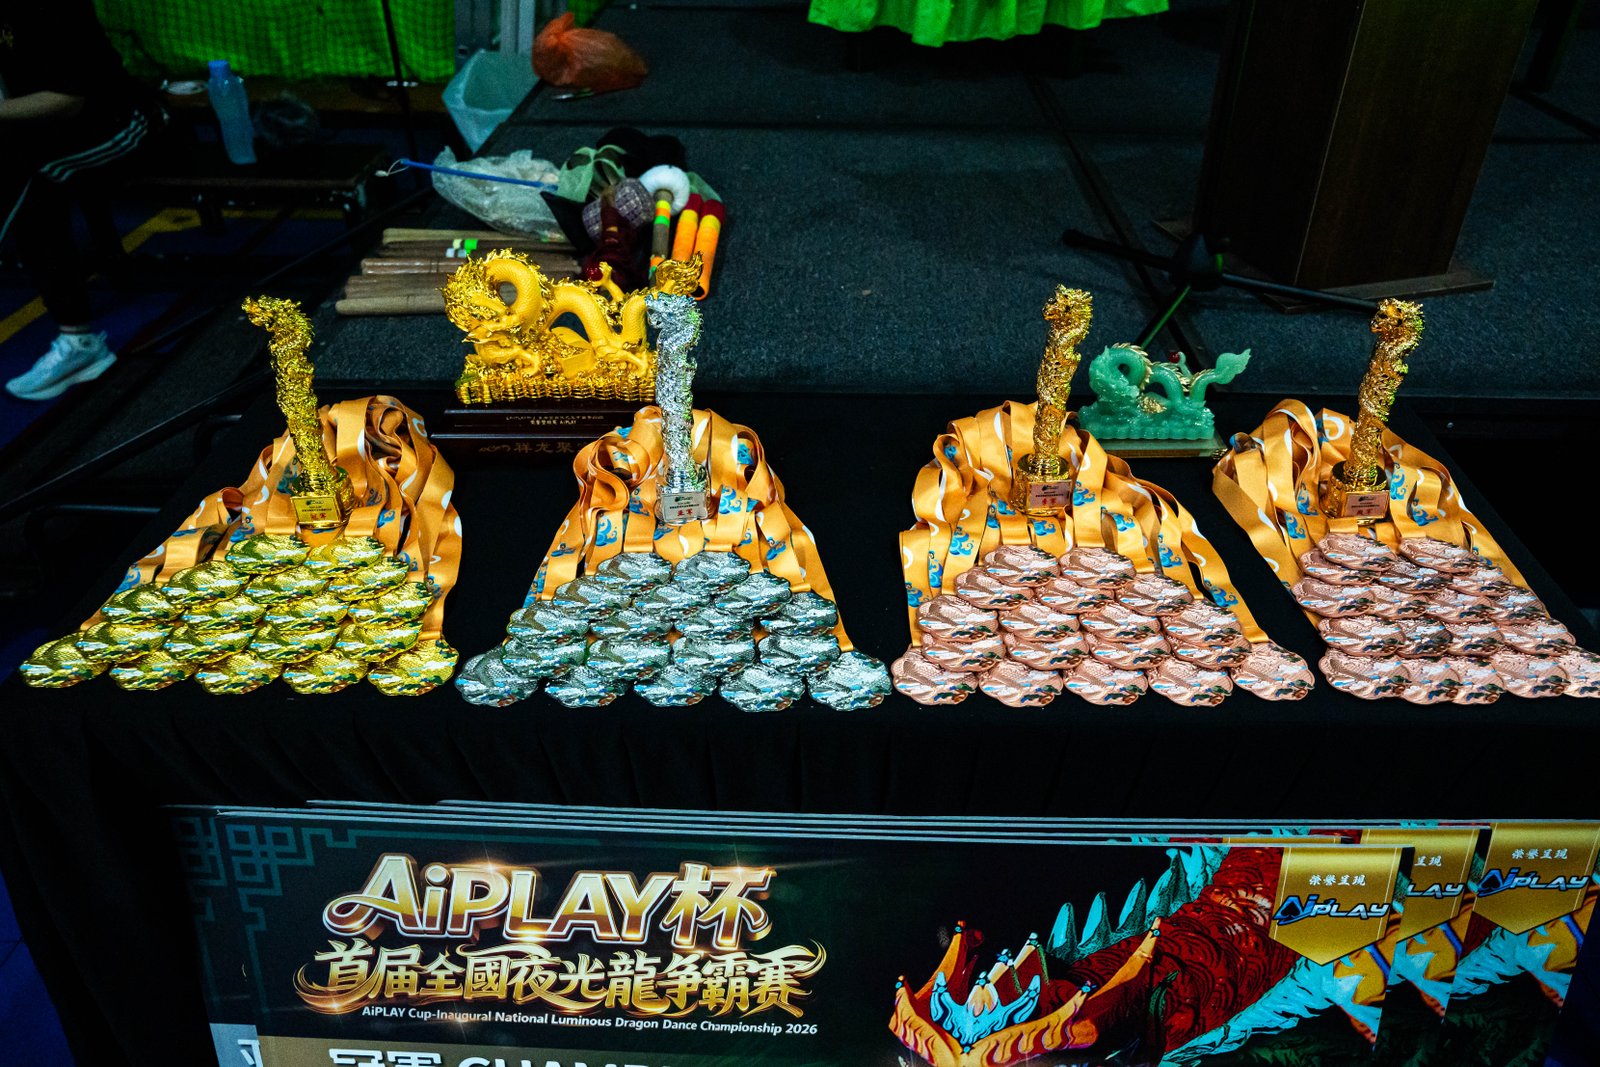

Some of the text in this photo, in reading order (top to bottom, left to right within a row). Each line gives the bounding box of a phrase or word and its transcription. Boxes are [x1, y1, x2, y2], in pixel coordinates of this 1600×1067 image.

[1414, 855, 1442, 867] 呈現
[322, 853, 776, 950] AiPLAY杯
[1406, 882, 1465, 899] LAY
[362, 1006, 818, 1036] AiPLAY Cup-Inaugural National Luminous Dragon Dance Championship 2026
